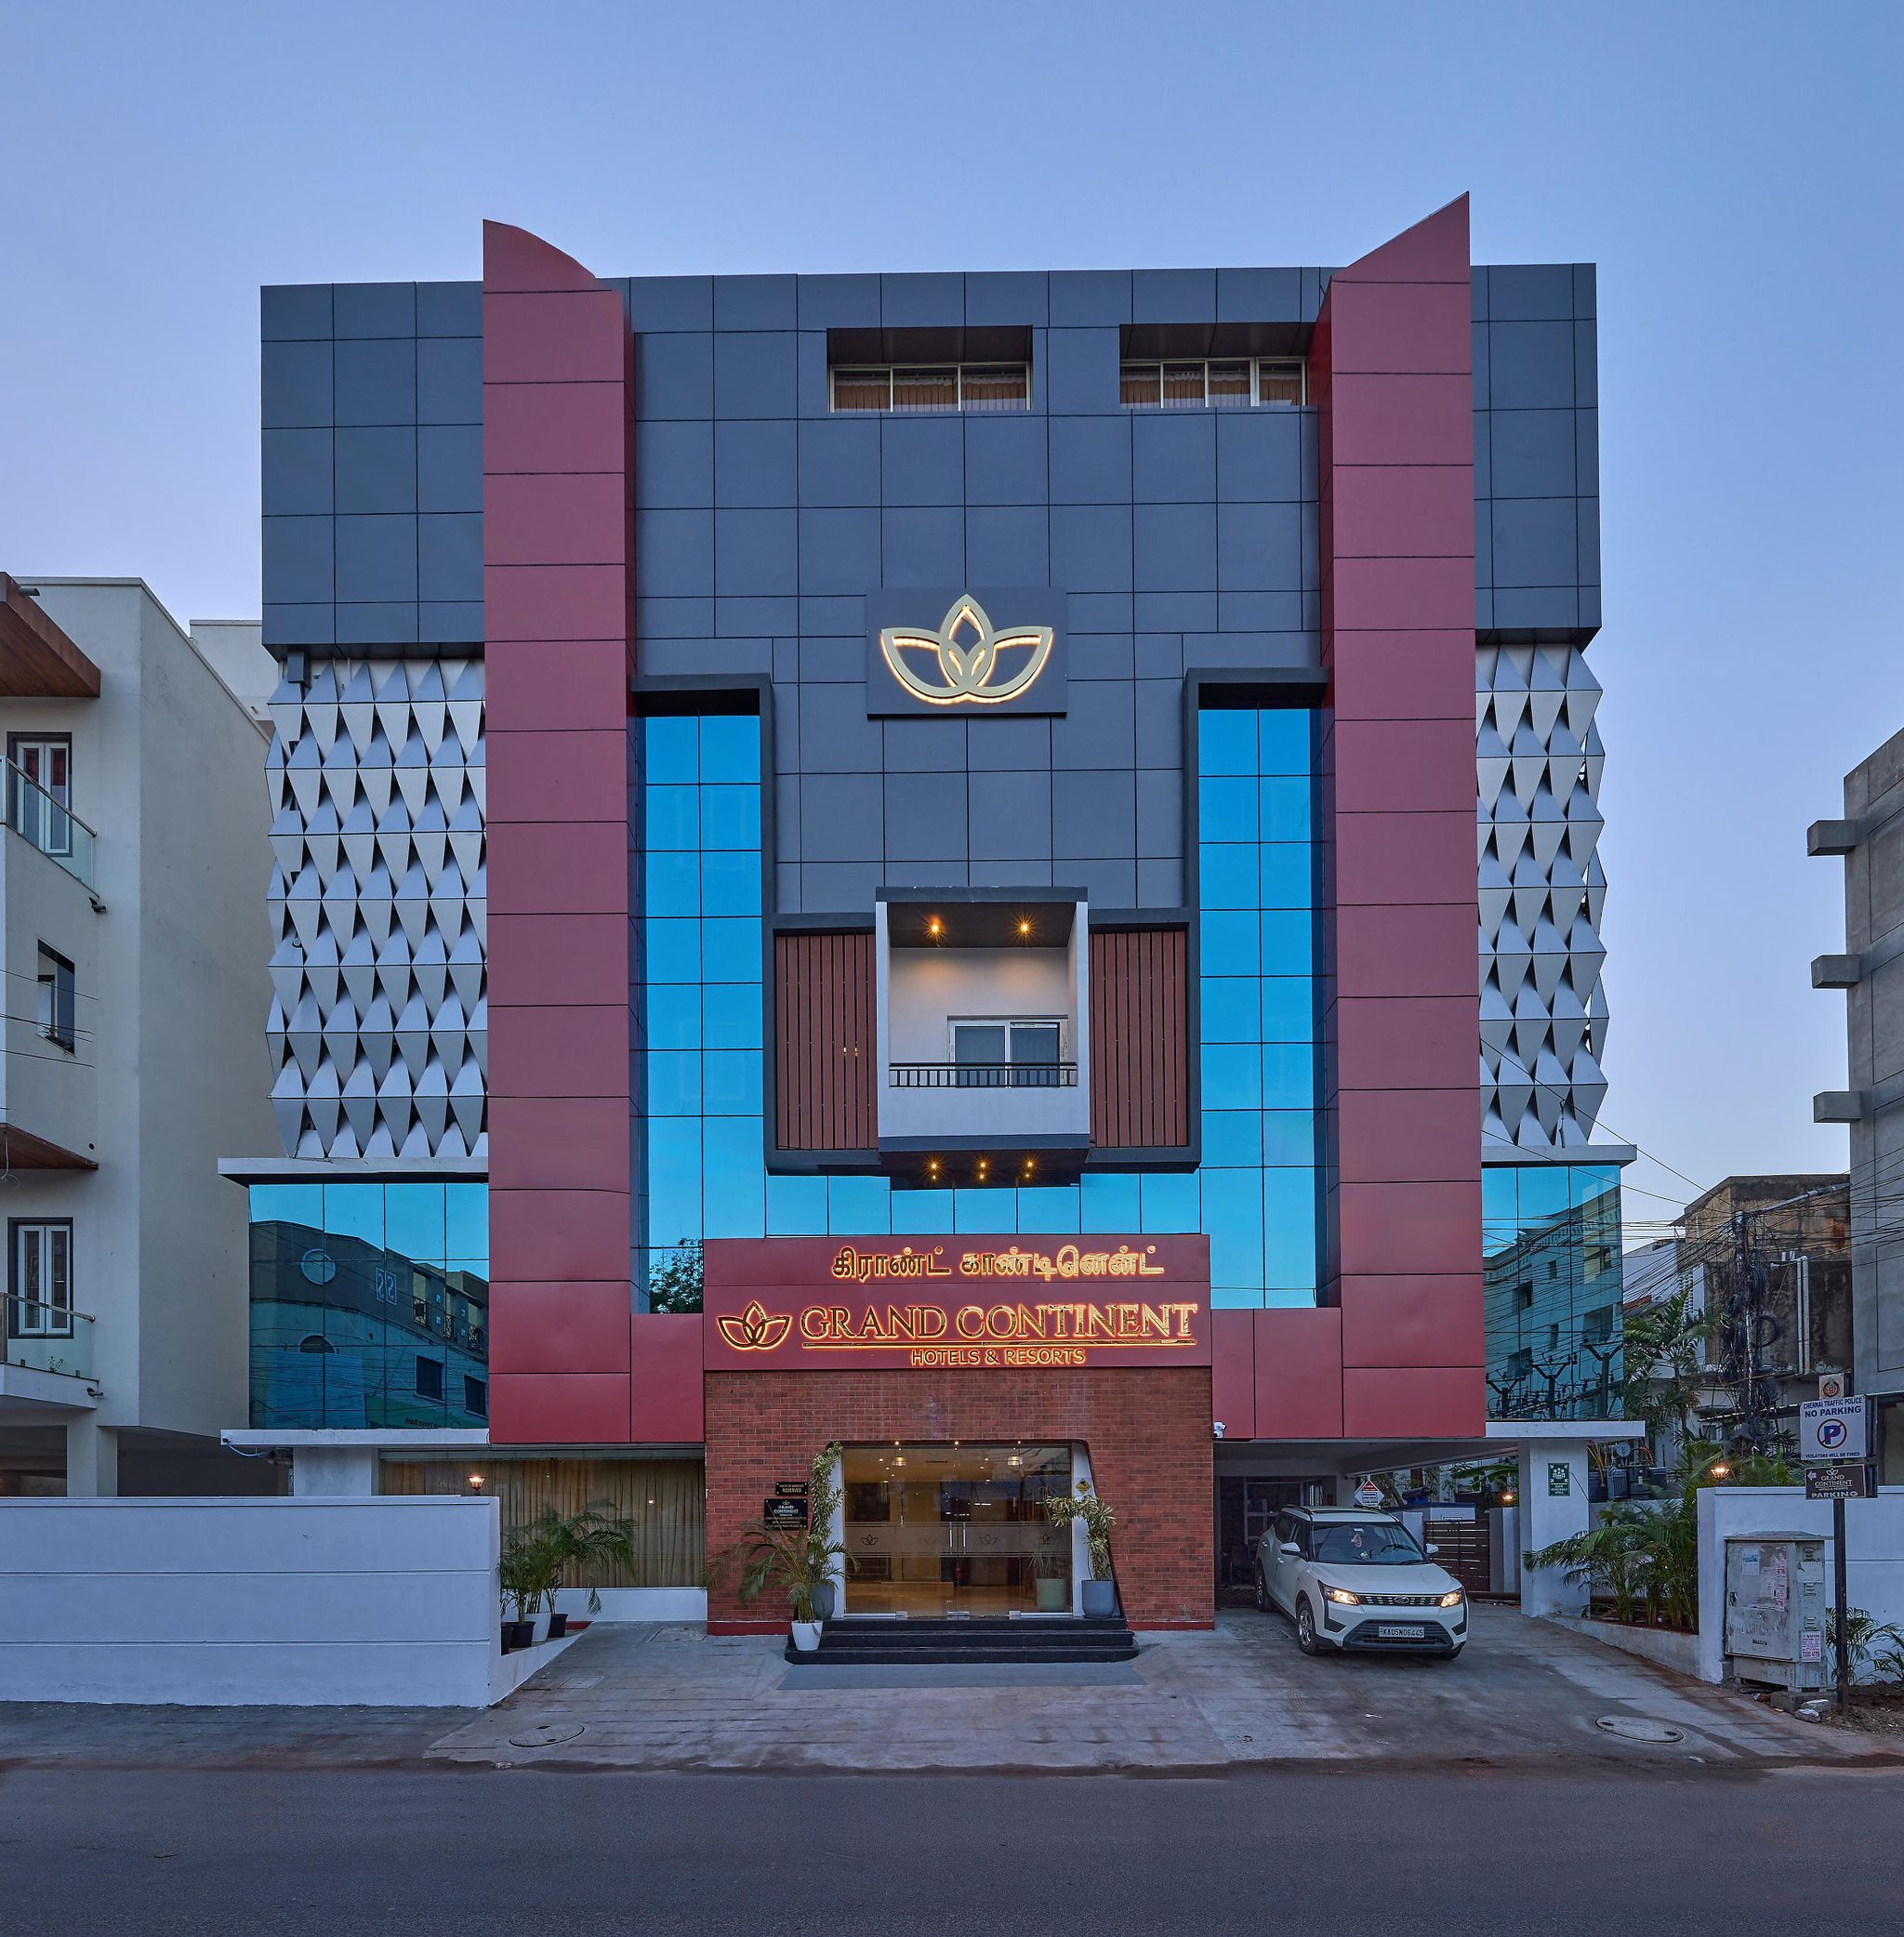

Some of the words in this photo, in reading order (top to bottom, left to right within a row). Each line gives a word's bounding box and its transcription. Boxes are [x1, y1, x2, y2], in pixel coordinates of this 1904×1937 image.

[800, 1305, 946, 1338] GRAND
[957, 1303, 1198, 1338] CONTINENT
[911, 1350, 980, 1365] HOTELS
[985, 1350, 998, 1364] &
[1005, 1349, 1085, 1364] RESORTS
[1804, 1402, 1823, 1410] CHENNAI
[1824, 1399, 1844, 1407] TRAFFIC
[1844, 1397, 1862, 1405] POLICE
[1805, 1410, 1818, 1418] NO
[1820, 1405, 1861, 1417] PARKING
